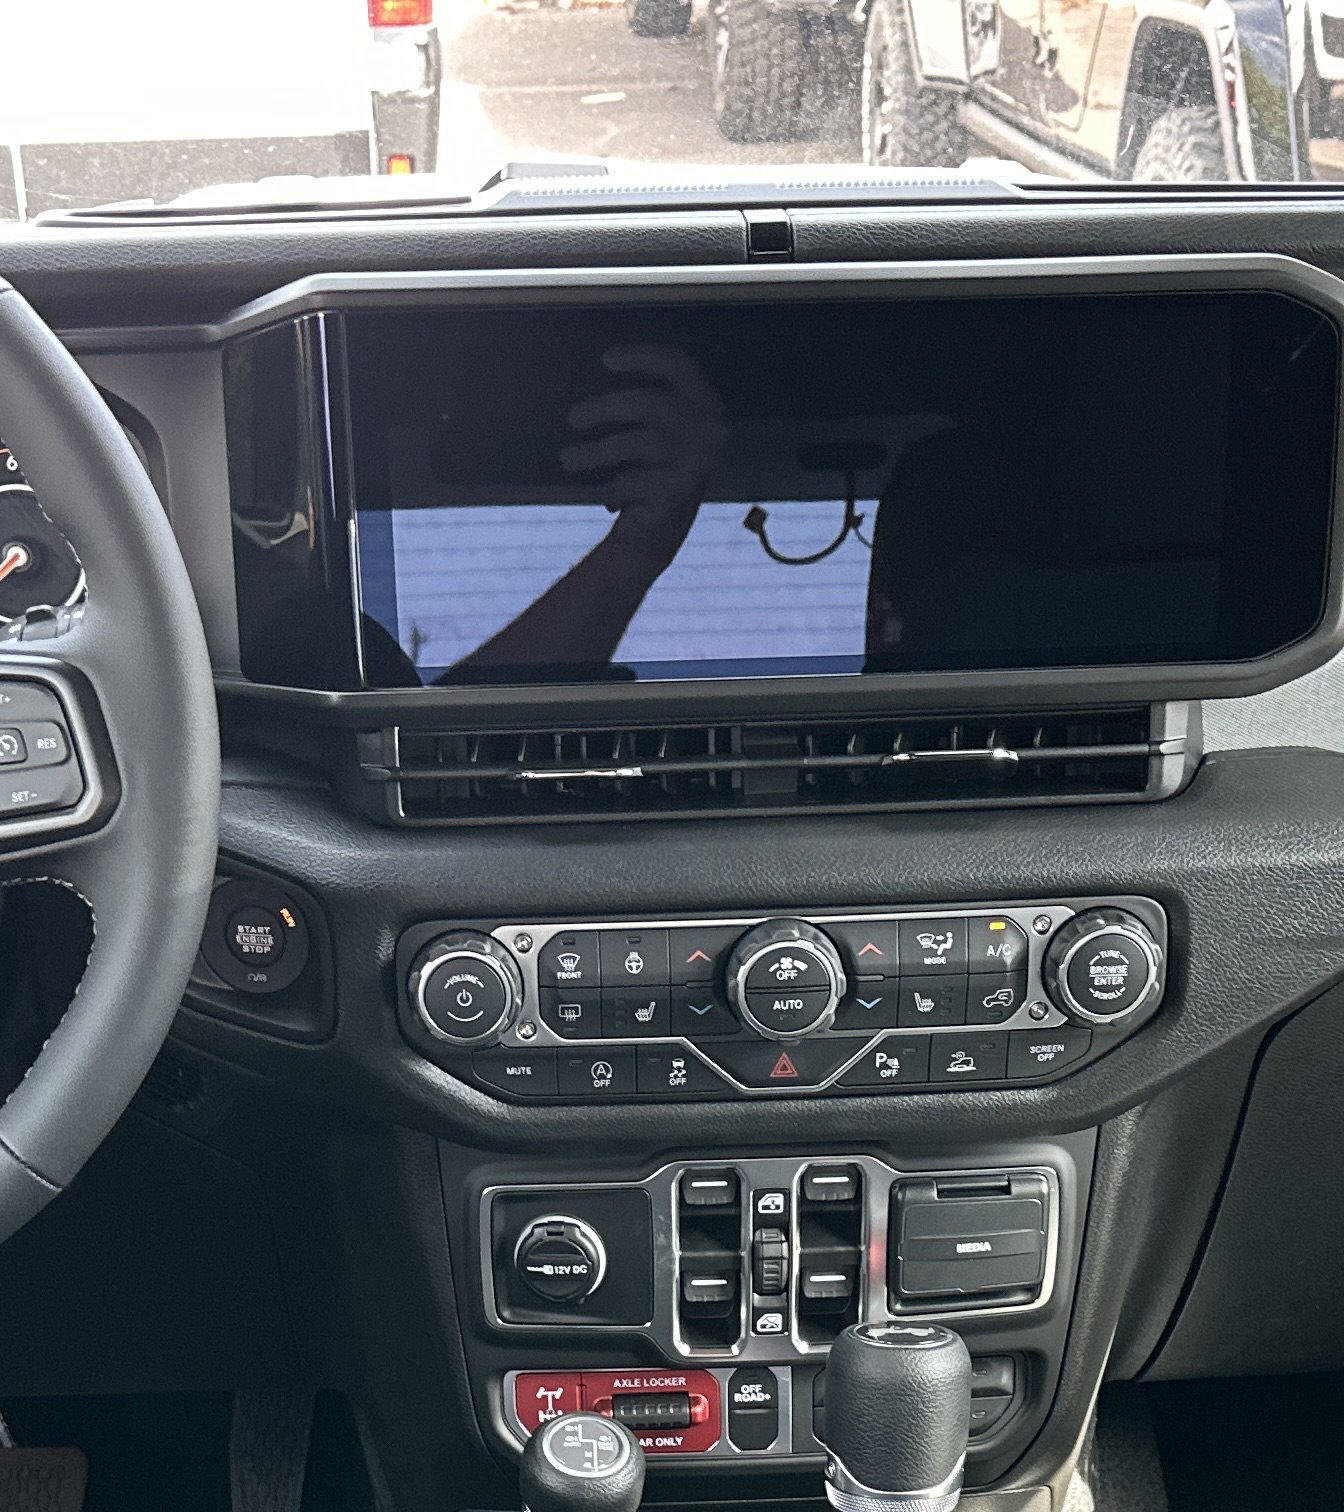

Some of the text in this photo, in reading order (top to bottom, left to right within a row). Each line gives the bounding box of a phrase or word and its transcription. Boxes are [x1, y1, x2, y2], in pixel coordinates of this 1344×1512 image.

[37, 737, 57, 749] RES
[237, 924, 271, 934] START
[235, 934, 274, 945] ENGINE
[242, 945, 271, 954] STOP
[986, 943, 1012, 958] A/C
[1099, 950, 1121, 960] TUNE
[923, 956, 947, 966] MODE
[556, 971, 582, 980] FRONT
[776, 968, 798, 982] OFF
[1089, 964, 1128, 976] BROWSE
[1094, 976, 1124, 987] ENTER
[773, 998, 803, 1012] AUTO
[1030, 1043, 1065, 1055] SCREEN
[1037, 1052, 1056, 1062] OFF
[506, 1066, 532, 1076] MUTE
[879, 1068, 899, 1079] OFF
[593, 1078, 611, 1089] OFF
[669, 1076, 687, 1087] OFF
[956, 1241, 992, 1254] MEDIA
[554, 1264, 571, 1275] 12V
[613, 1376, 686, 1388] AXLE LOCKER
[740, 1384, 763, 1395] OFF
[656, 1436, 683, 1448] ONLY
